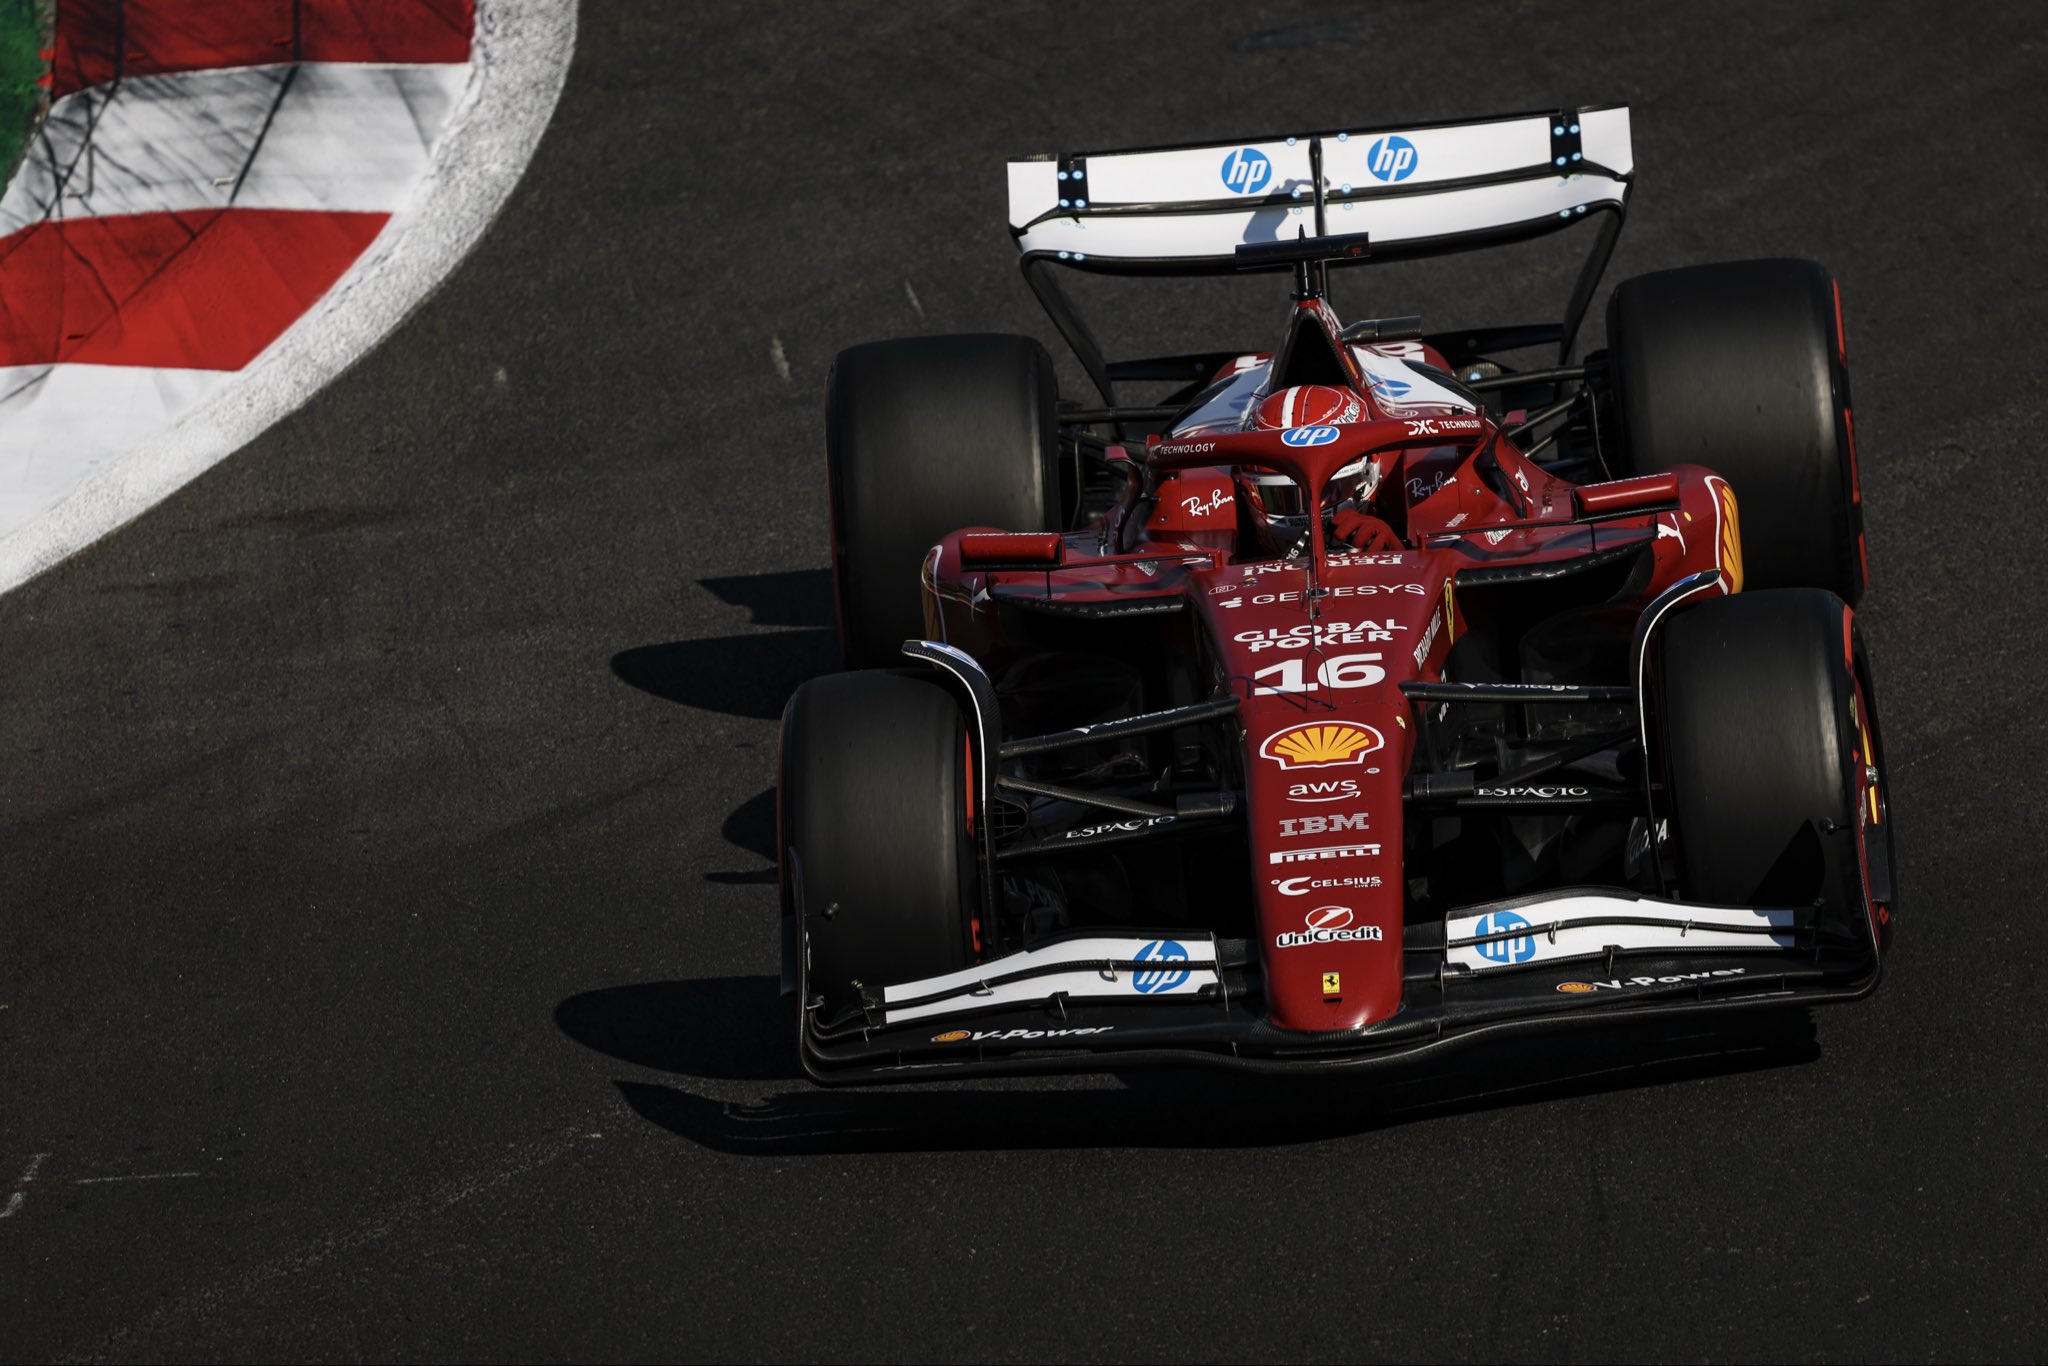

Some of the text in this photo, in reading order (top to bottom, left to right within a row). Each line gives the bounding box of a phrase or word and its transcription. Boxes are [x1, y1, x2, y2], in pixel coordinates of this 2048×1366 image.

[1226, 148, 1268, 194] hp
[1372, 136, 1414, 182] hp
[1161, 442, 1216, 455] TECHNOLOGY
[1290, 426, 1333, 447] hp
[1405, 470, 1457, 498] Ray-Ban
[1181, 488, 1234, 517] Ray-Ban
[1252, 583, 1426, 605] GEESYS
[1233, 619, 1408, 643] GLOBAL
[1248, 630, 1394, 653] POKER
[1254, 652, 1386, 696] 16
[1288, 779, 1358, 796] aws
[1478, 787, 1589, 798] ESPACIO
[1066, 815, 1176, 839] ESPACIO
[1279, 812, 1370, 837] IBM
[1269, 843, 1382, 864] PIRELLI
[1311, 876, 1382, 888] CELSIUS
[1276, 926, 1383, 948] UniCredit
[1486, 911, 1528, 963] hp
[1136, 941, 1188, 993] hp
[1594, 966, 1747, 993] V-Power
[972, 1024, 1115, 1042] V-Power
